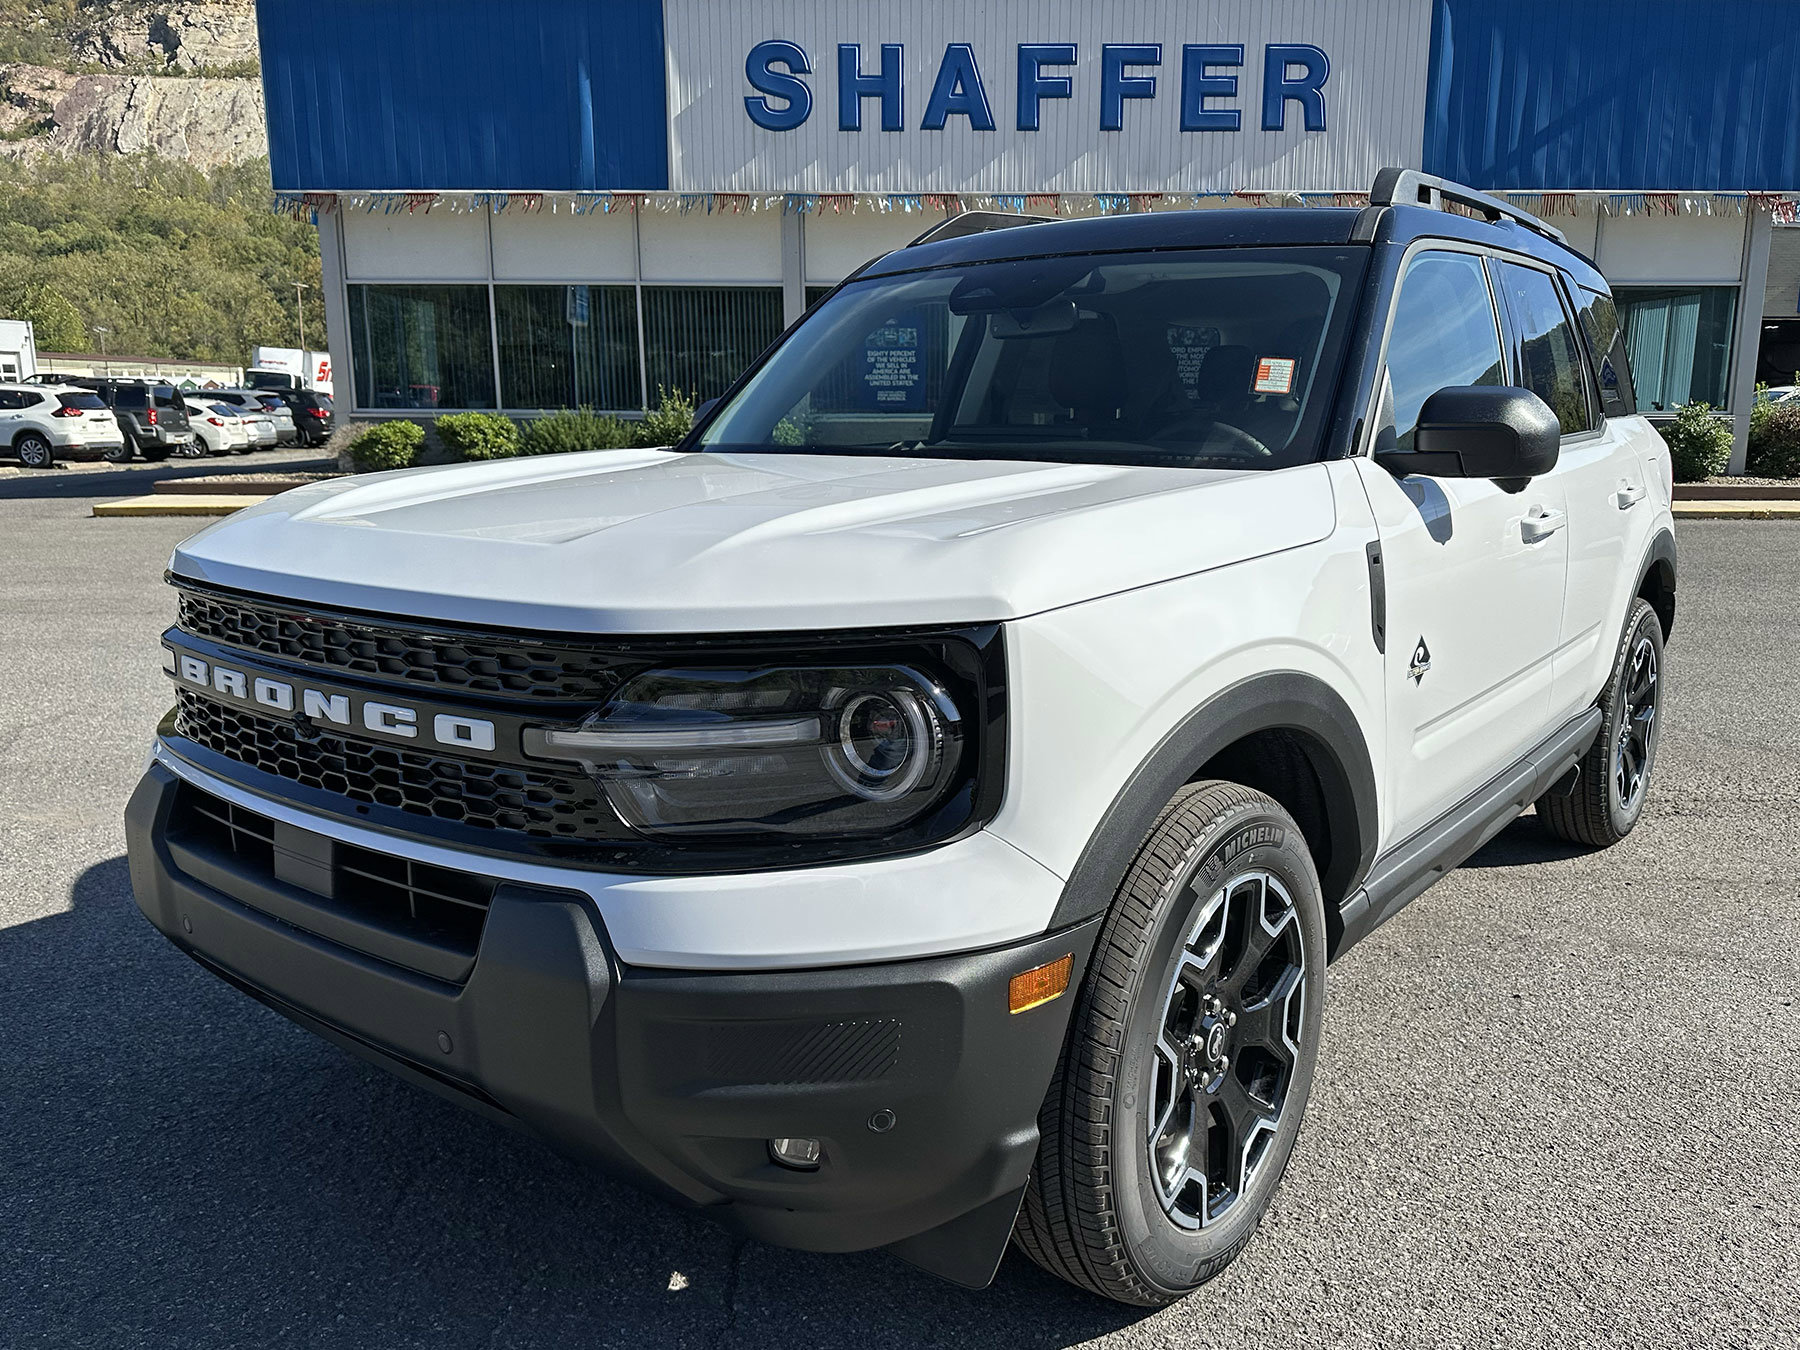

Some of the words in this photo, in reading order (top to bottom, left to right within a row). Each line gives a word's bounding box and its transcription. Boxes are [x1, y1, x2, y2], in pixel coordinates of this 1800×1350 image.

[744, 39, 1331, 132] SHAFFER
[180, 654, 496, 752] BRONCO
[1224, 826, 1284, 863] MICHELIN
